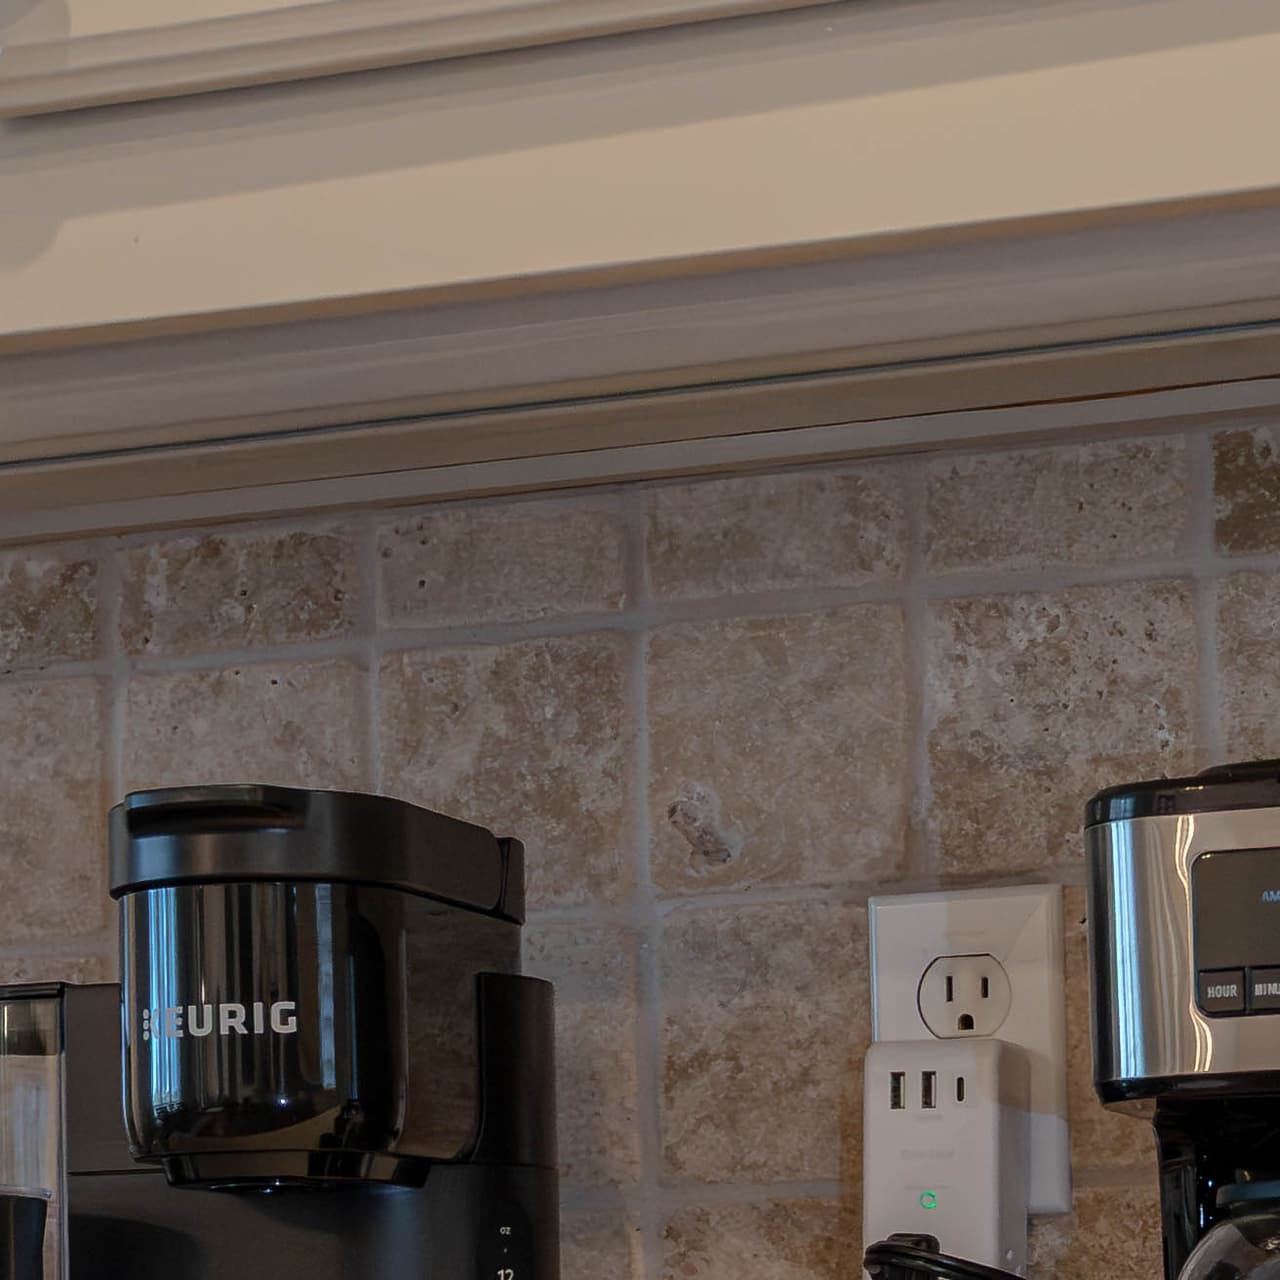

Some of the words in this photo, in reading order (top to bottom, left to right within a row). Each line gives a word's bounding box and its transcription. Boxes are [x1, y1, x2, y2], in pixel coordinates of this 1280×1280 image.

[1207, 985, 1238, 998] HOUR
[143, 1001, 297, 1041] KEURIG
[499, 1227, 511, 1235] oz
